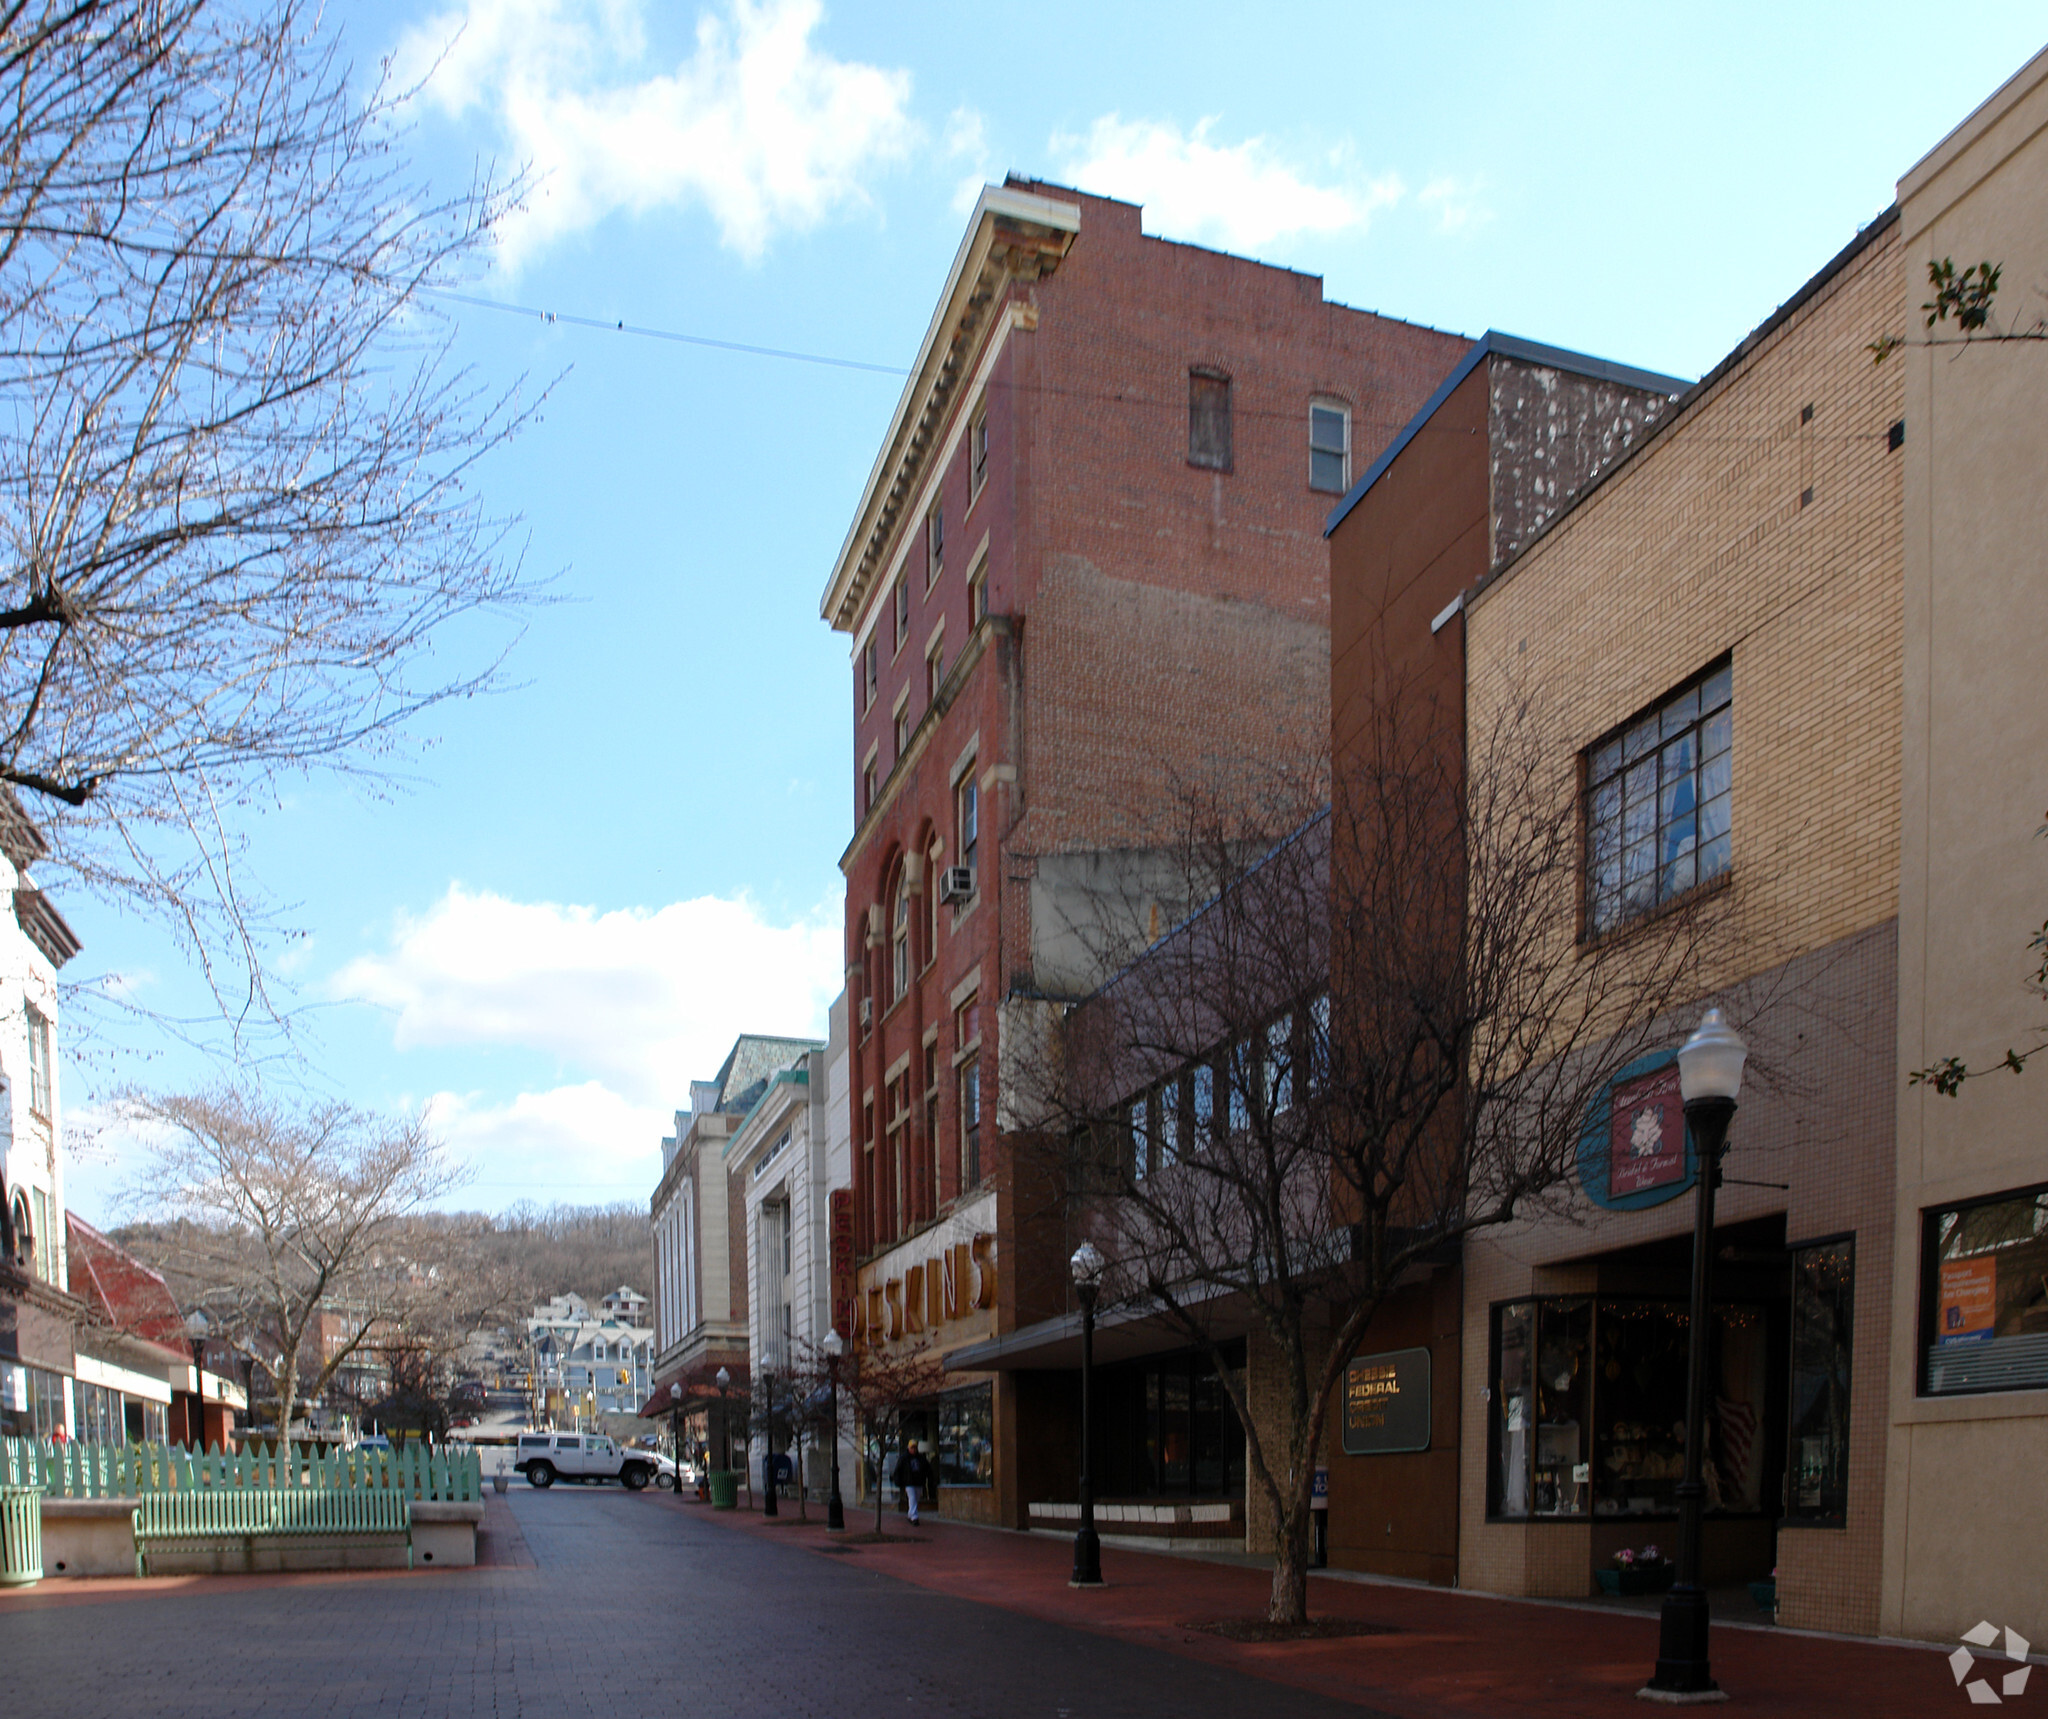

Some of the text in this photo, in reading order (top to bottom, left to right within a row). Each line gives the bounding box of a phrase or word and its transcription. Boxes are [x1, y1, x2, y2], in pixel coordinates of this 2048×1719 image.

[1943, 1269, 1972, 1280] Passport
[1943, 1276, 1990, 1289] Requirements
[850, 1233, 996, 1351] PESKINS
[1955, 1285, 1989, 1297] Changing
[1349, 1380, 1400, 1399] FEDERAL
[1349, 1397, 1389, 1414] CREDIT
[1349, 1414, 1385, 1429] UNION
